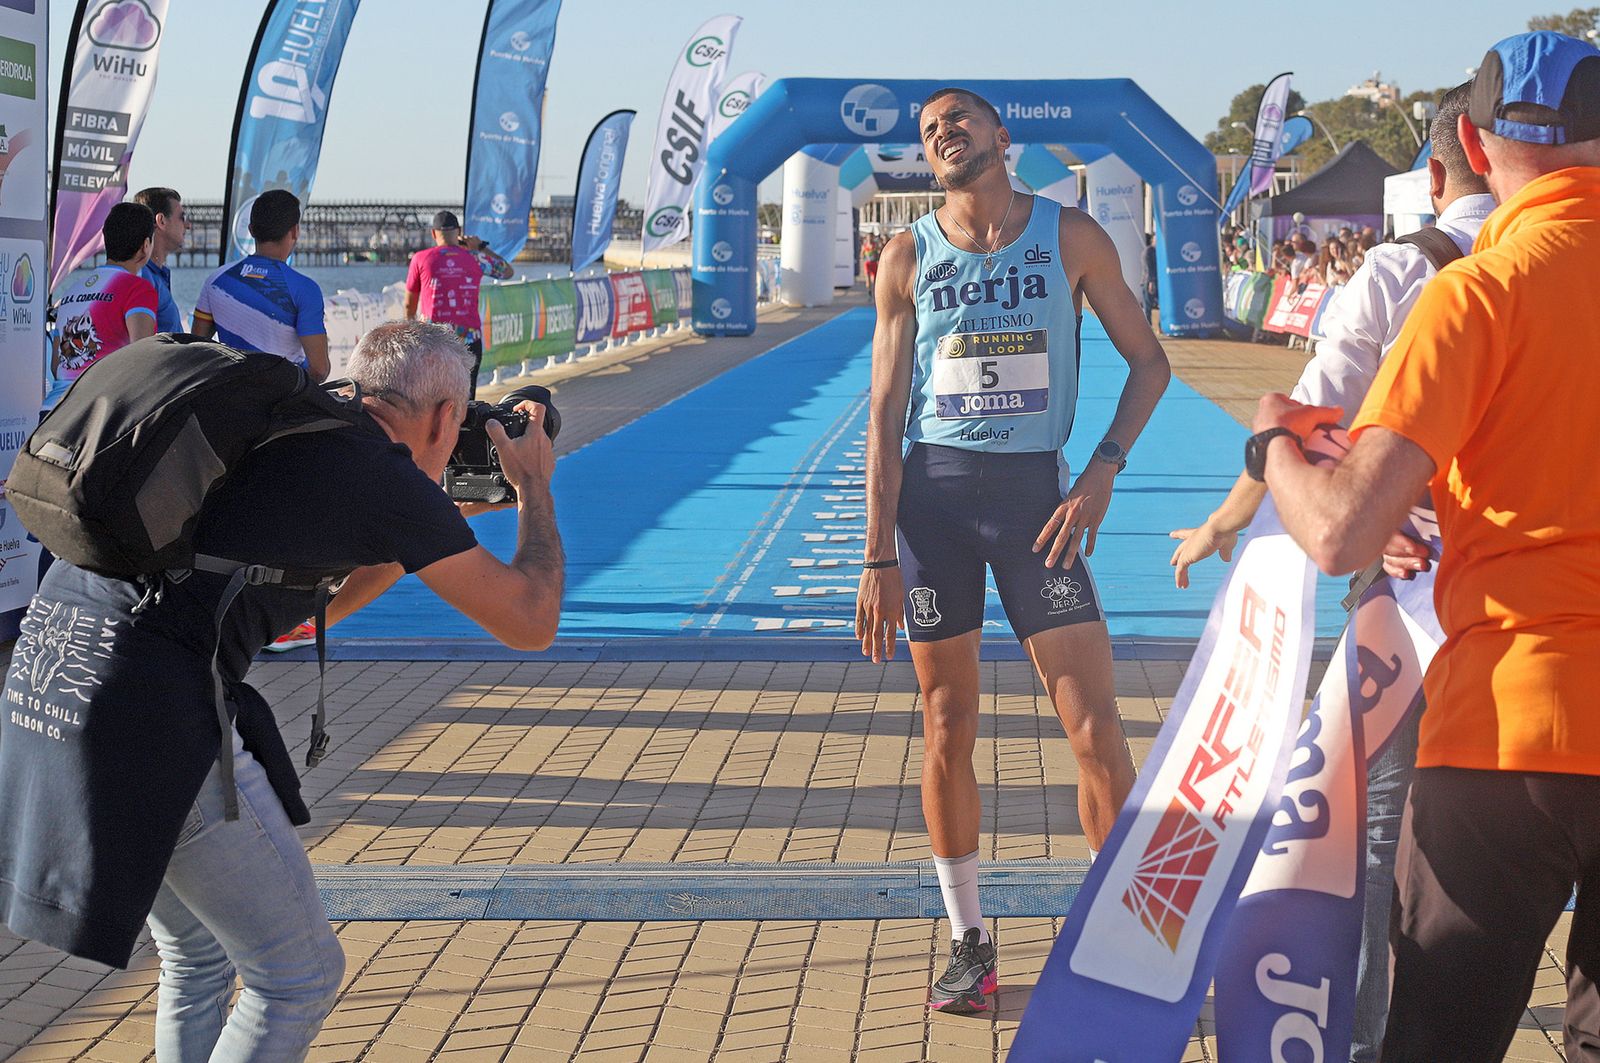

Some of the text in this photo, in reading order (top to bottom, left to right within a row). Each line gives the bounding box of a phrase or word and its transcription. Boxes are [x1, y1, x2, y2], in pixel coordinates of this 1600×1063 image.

[278, 0, 326, 67] HUEL
[694, 44, 726, 61] CSIF
[93, 53, 147, 77] WiHu
[1006, 102, 1072, 120] Huelva
[71, 112, 118, 132] FIBRA
[660, 88, 705, 187] CSIF
[67, 141, 115, 162] MÓVIL
[698, 208, 718, 217] Puerto
[727, 208, 750, 217] Huelva
[697, 265, 716, 273] Puerto
[727, 265, 749, 273] Huelva
[930, 265, 1049, 312] nerja
[13, 309, 31, 325] WiHu
[953, 312, 1034, 334] ATLETISMO
[973, 333, 1034, 344] RUNNING
[989, 344, 1025, 354] LOOP
[980, 361, 999, 388] 5
[0, 431, 26, 451] UELVA
[960, 427, 1012, 441] Huelva
[1052, 597, 1080, 608] NERJA
[7, 688, 81, 726] TIME TO CHILL
[11, 711, 66, 742] SILBON CO.
